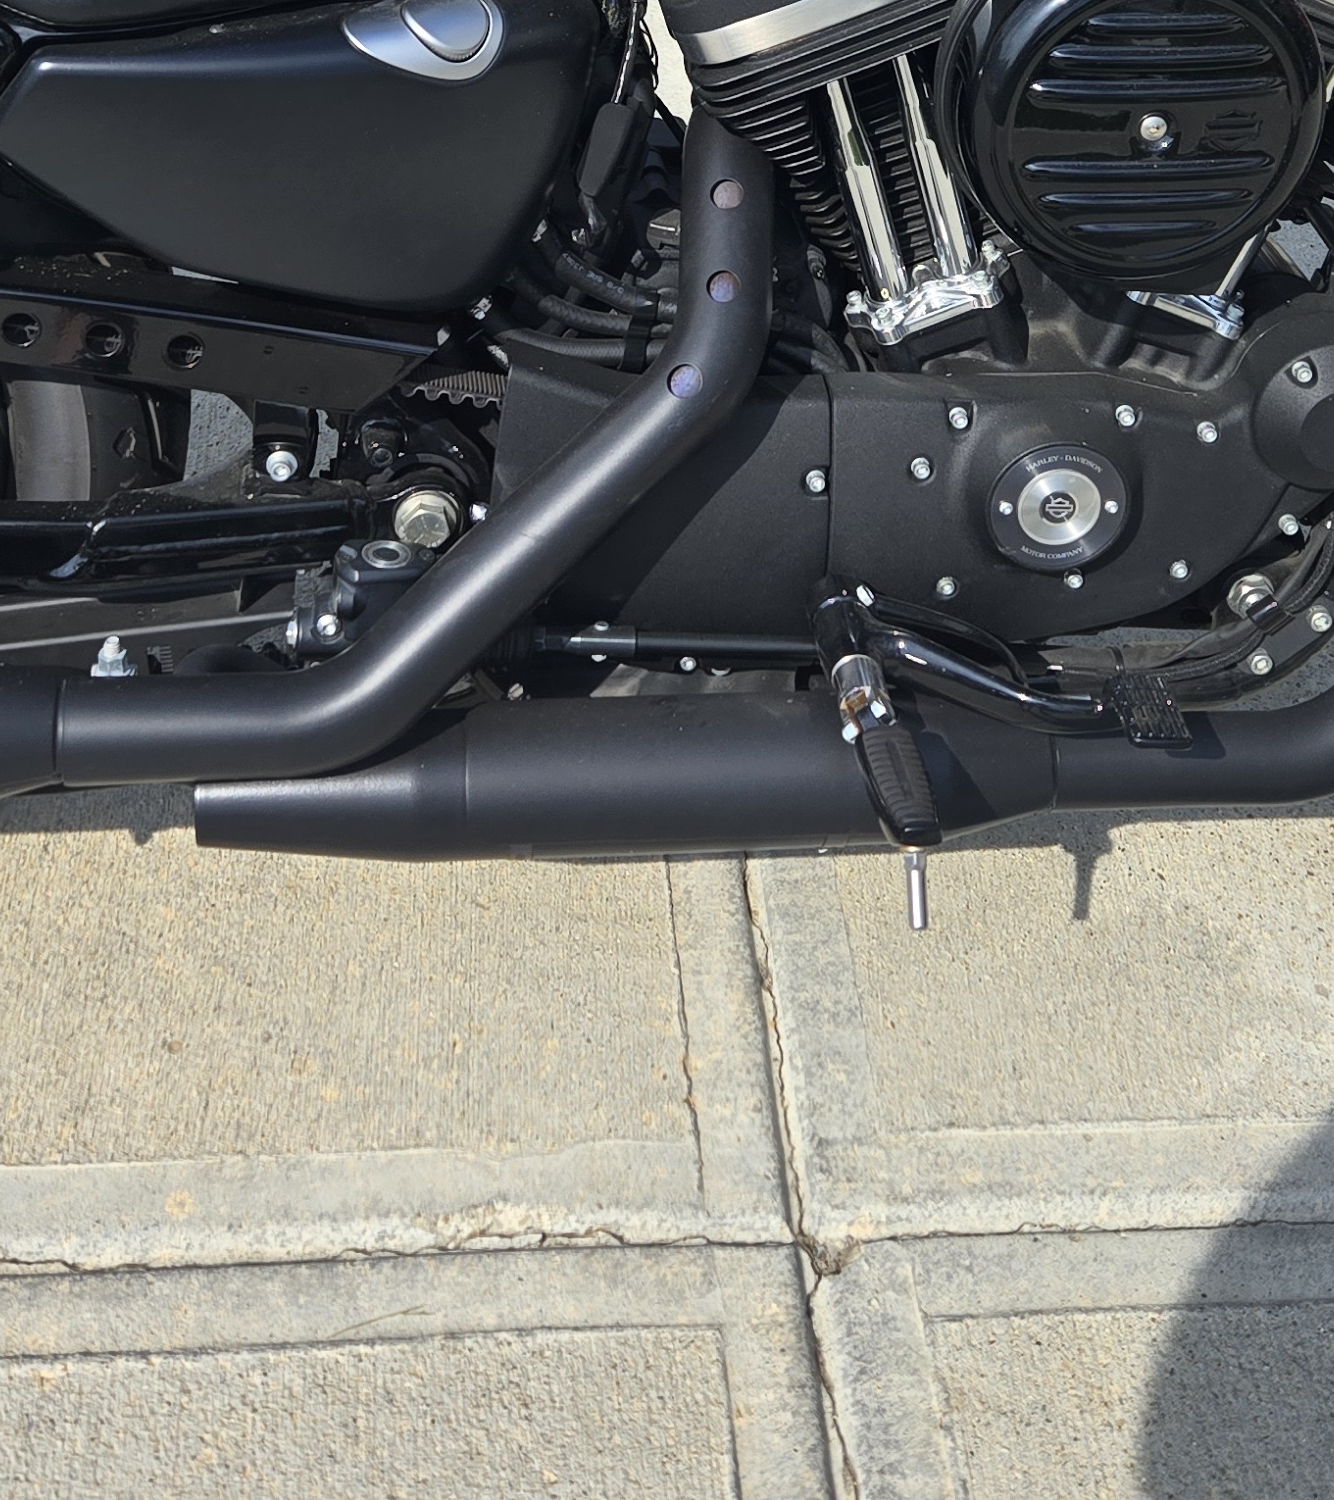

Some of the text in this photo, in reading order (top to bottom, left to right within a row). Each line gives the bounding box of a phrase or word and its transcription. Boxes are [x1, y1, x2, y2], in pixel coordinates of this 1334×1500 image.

[1025, 454, 1103, 473] HARLEY DAVIDSON
[1021, 545, 1084, 559] MOTOR COMPANY
